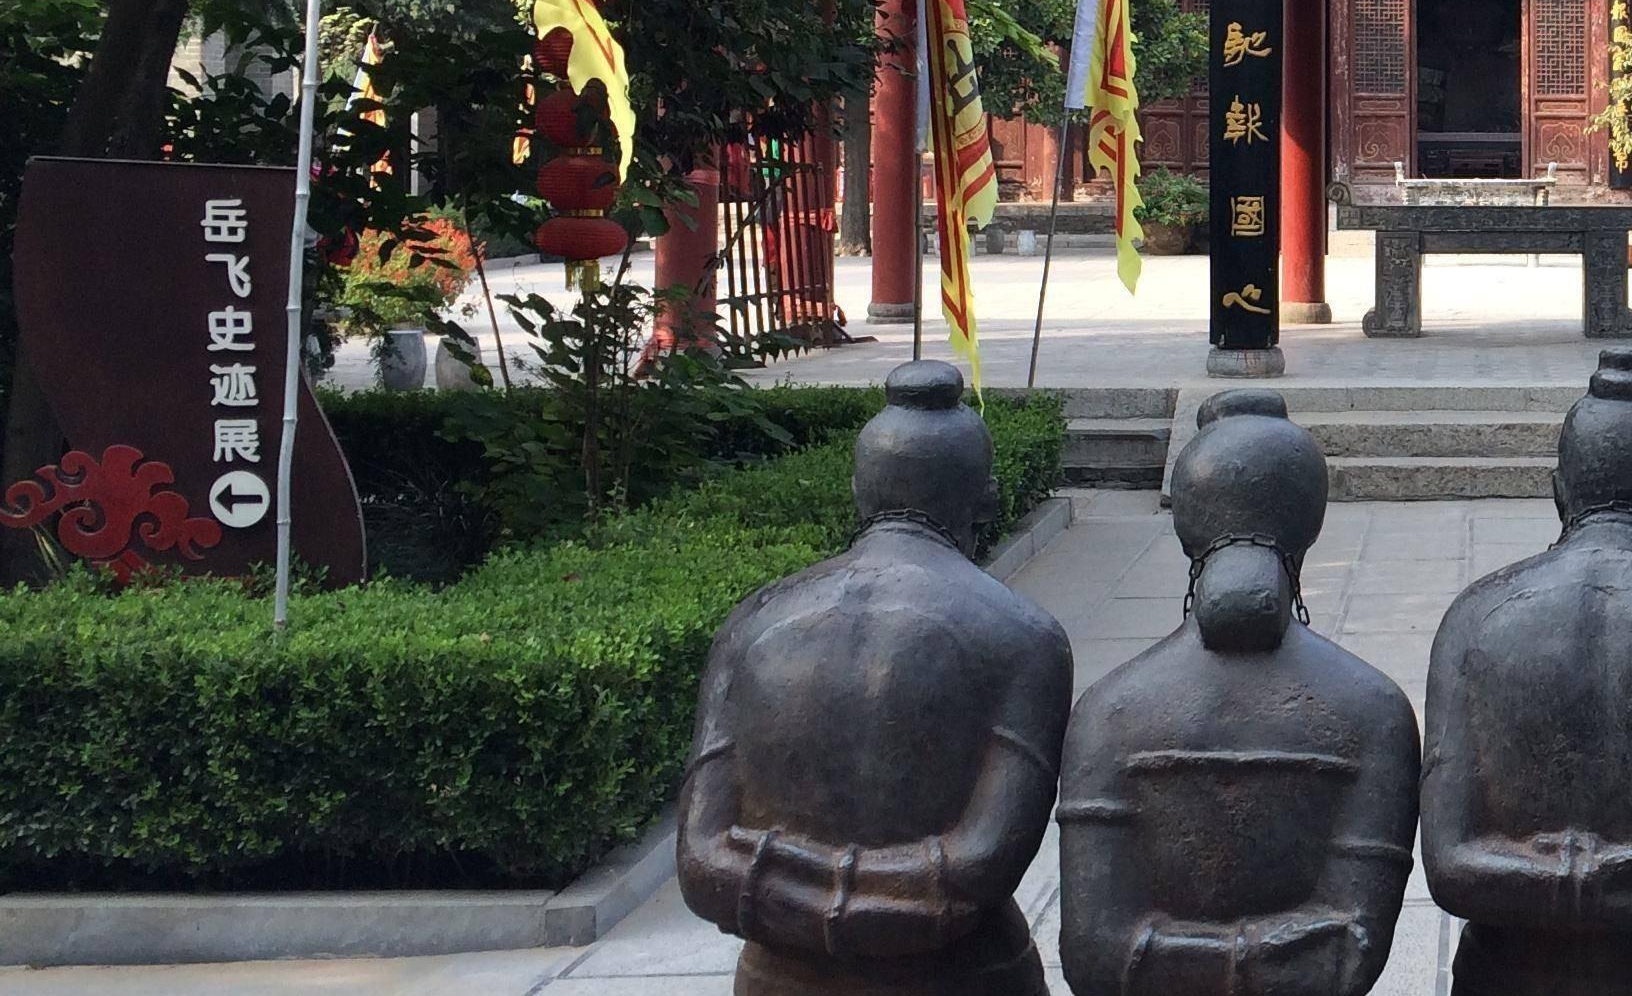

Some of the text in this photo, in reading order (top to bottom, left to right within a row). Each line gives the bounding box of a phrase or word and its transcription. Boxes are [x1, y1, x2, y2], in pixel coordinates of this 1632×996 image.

[200, 198, 262, 464] 岳飞史迹展
